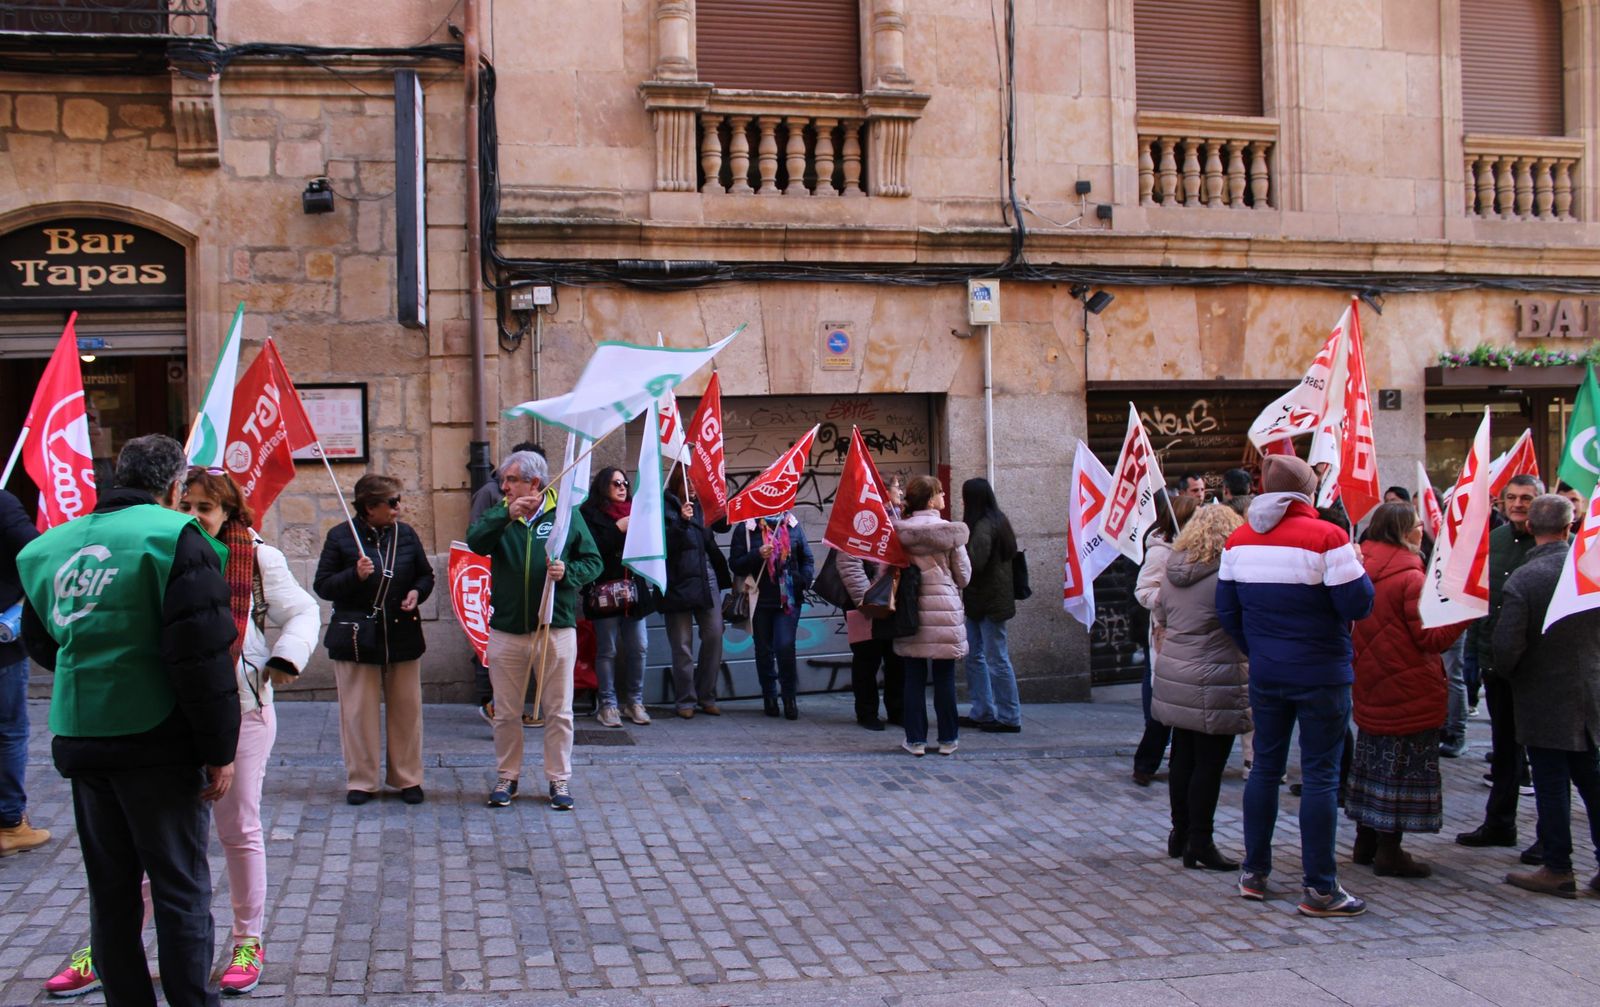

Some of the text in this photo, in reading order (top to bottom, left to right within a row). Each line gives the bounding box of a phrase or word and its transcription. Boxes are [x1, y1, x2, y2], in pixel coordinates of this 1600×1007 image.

[42, 228, 135, 255] Bar
[11, 260, 167, 291] Tapas
[1385, 391, 1397, 409] 2
[711, 479, 727, 507] León
[60, 568, 119, 599] CSIF
[461, 575, 486, 634] UGT
